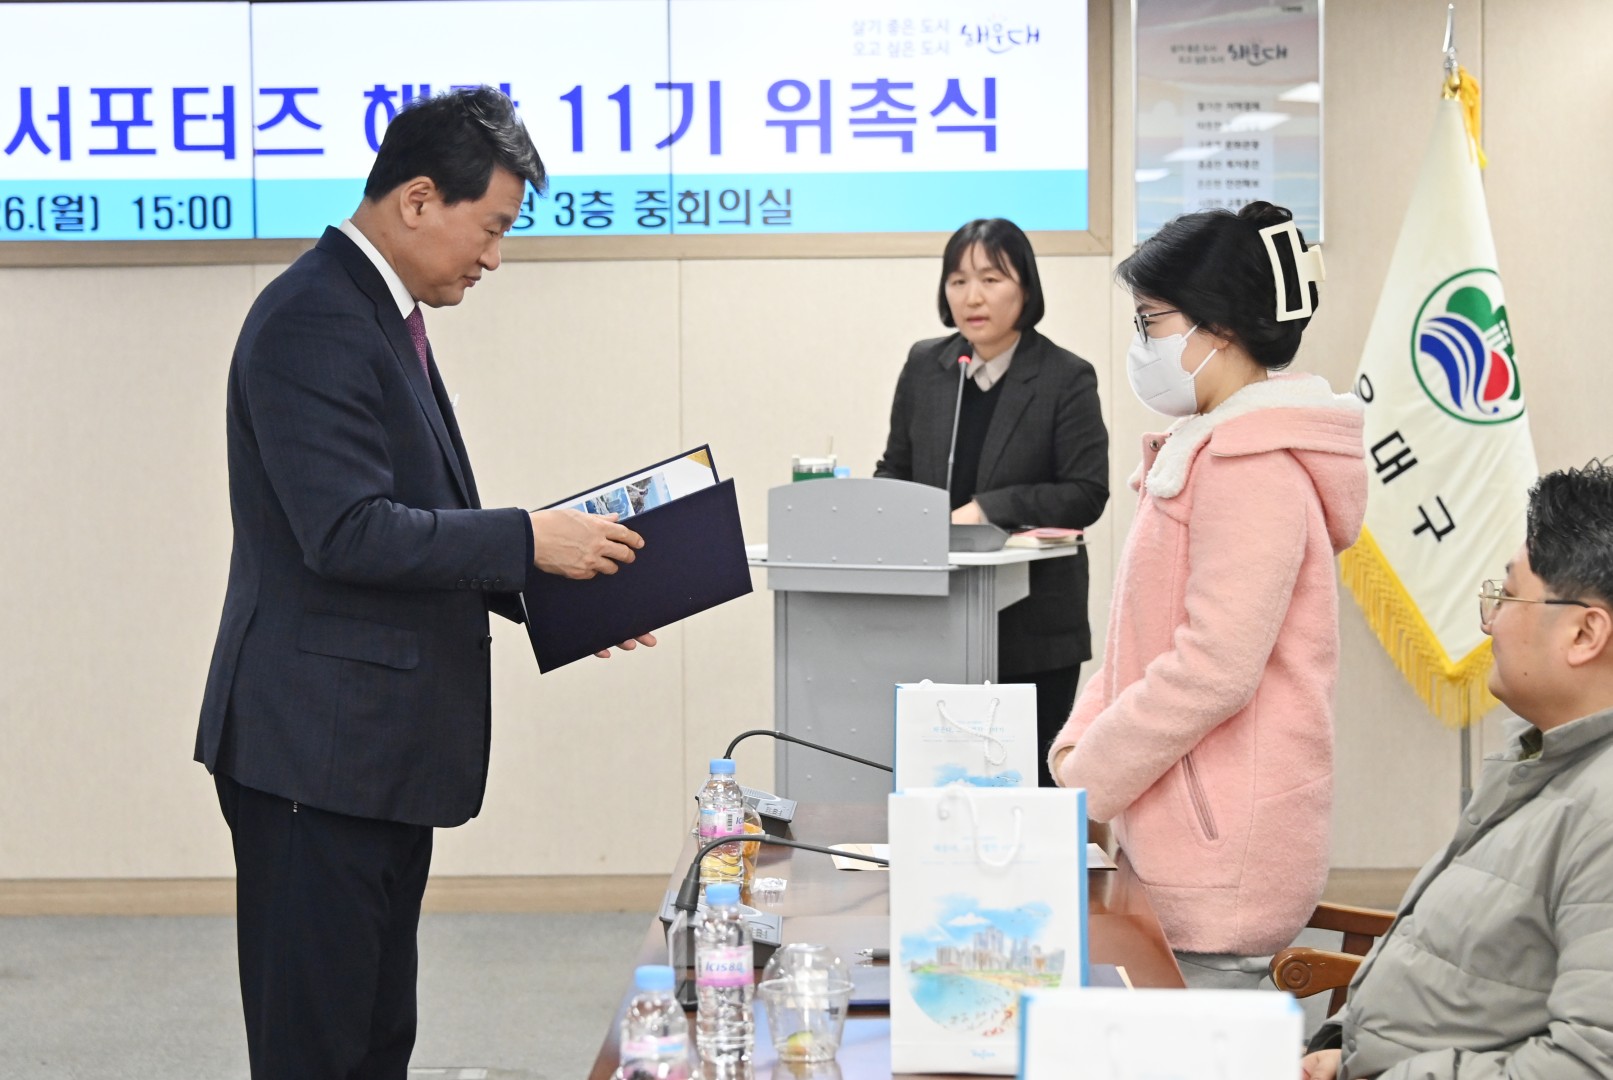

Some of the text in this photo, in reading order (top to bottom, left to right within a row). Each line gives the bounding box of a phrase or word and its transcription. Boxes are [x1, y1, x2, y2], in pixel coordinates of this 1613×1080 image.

[4, 86, 324, 161] 서포터즈
[560, 80, 721, 155] 11기
[766, 77, 996, 154] 위촉식
[0, 195, 231, 232] 6.(월) 15:00
[555, 190, 614, 229] 3층
[635, 189, 792, 229] 중회의실
